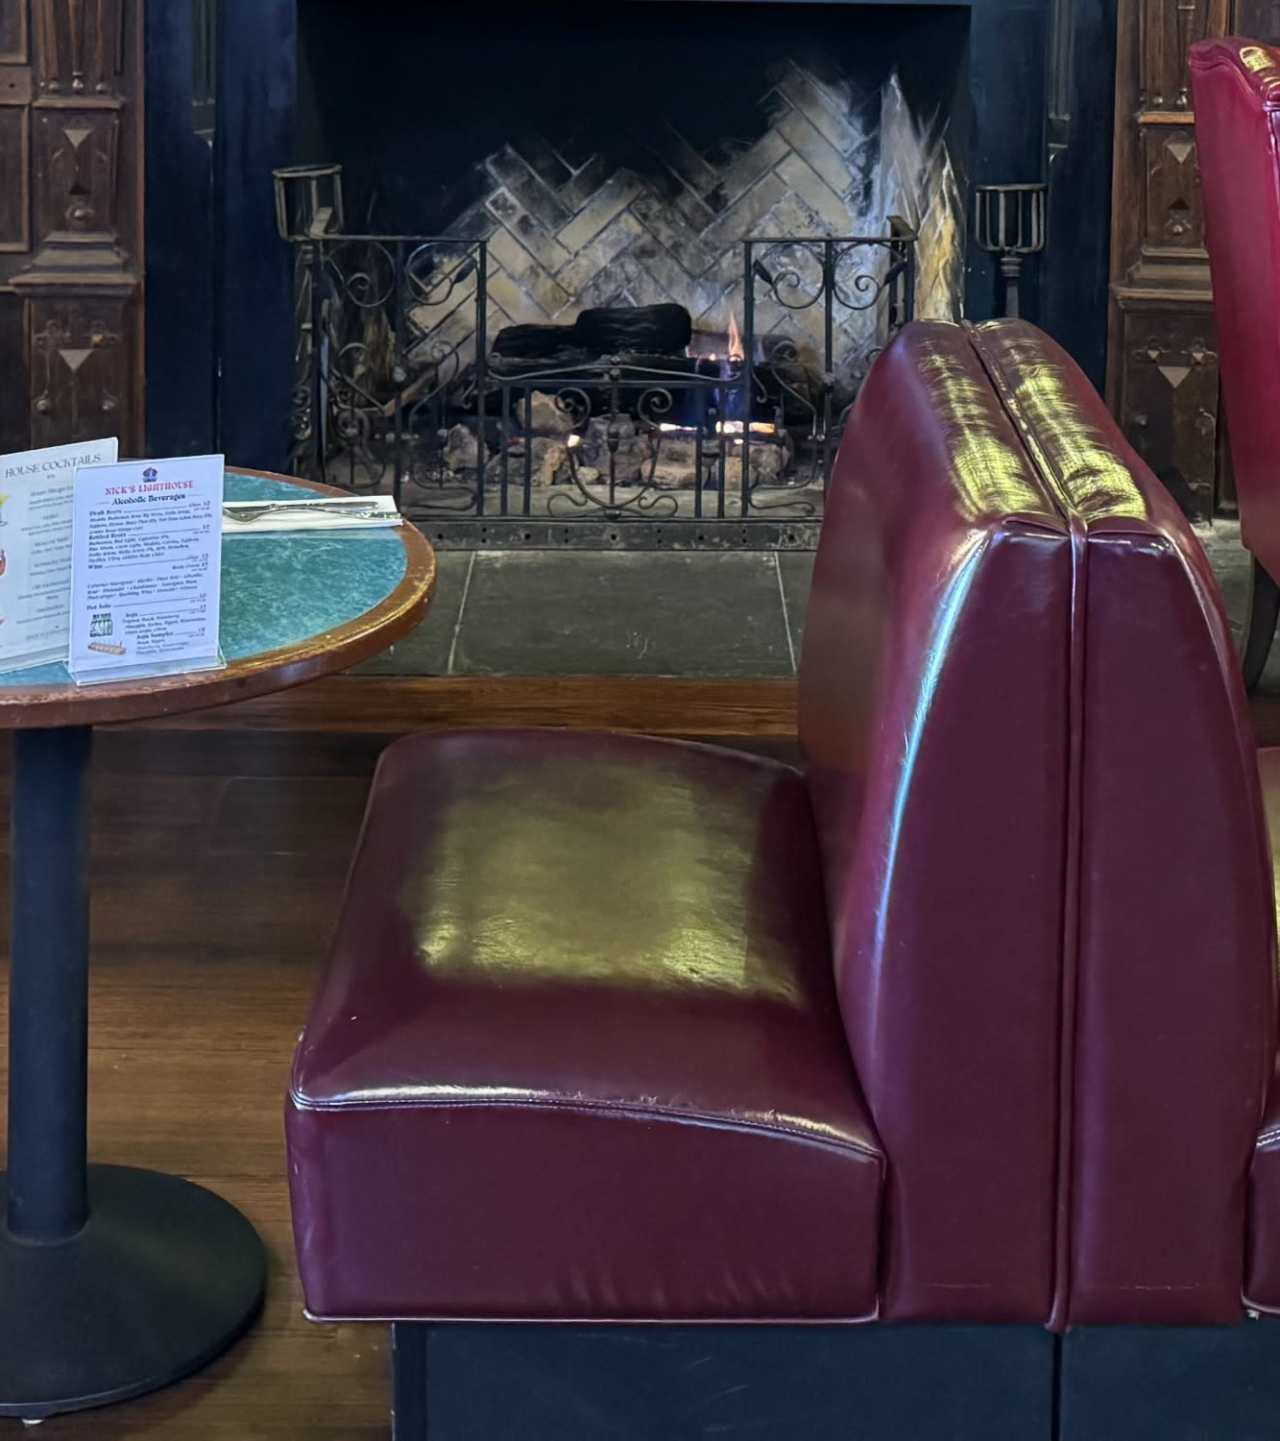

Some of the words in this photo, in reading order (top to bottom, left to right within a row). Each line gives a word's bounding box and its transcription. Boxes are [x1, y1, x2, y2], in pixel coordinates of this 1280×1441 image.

[5, 463, 40, 479] HOUSE
[42, 453, 101, 472] COCKTAILS
[105, 485, 136, 495] NICK'S
[138, 480, 193, 493] LIGHTHOUSE
[111, 495, 146, 505] Alcoholic
[148, 493, 186, 504] Beverages
